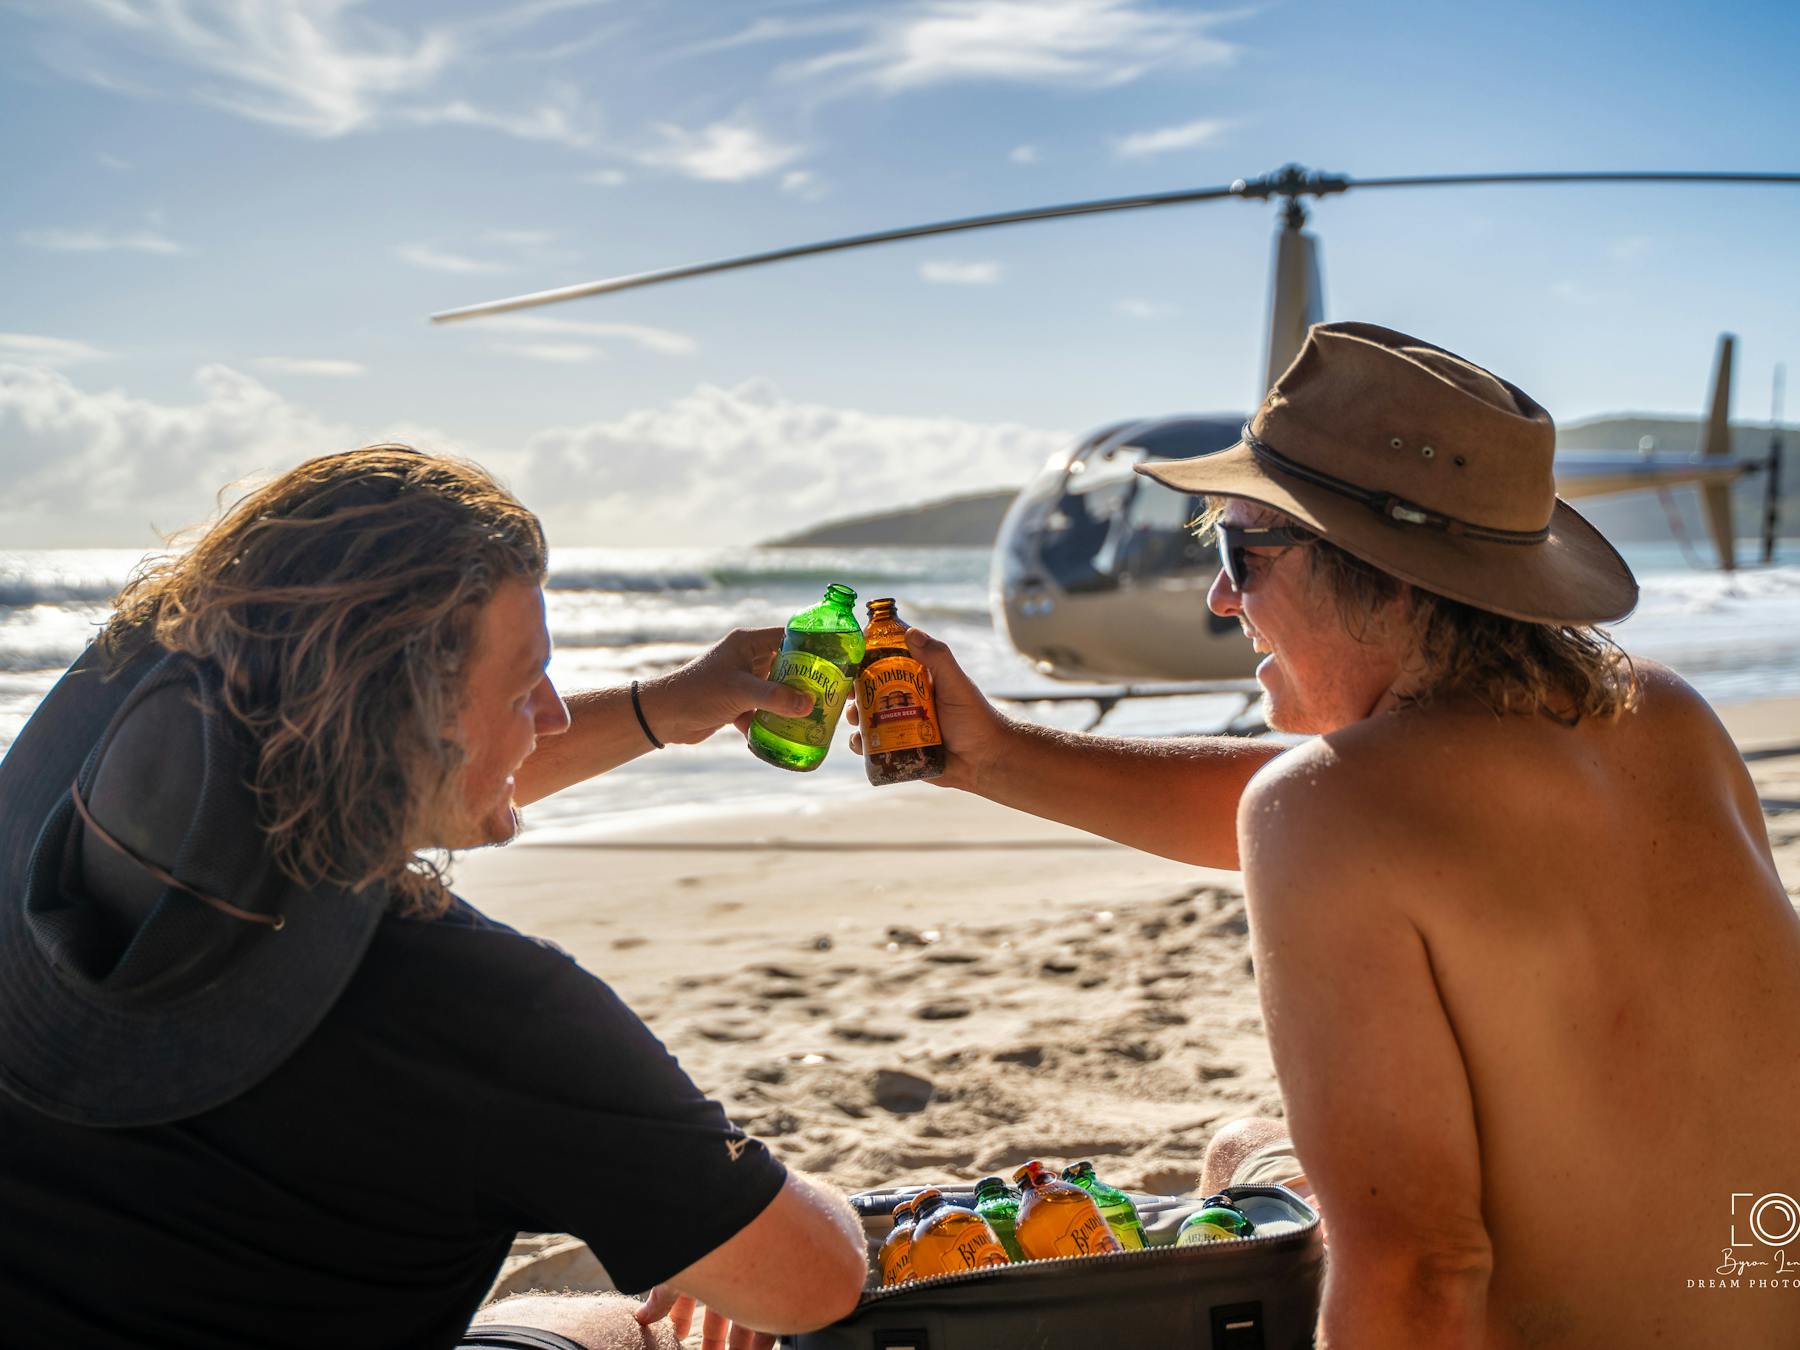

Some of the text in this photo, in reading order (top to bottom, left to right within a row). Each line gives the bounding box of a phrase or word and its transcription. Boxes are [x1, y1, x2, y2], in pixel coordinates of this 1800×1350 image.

[777, 659, 839, 707] BUNDABERG
[863, 669, 927, 709] BUNDABERG
[880, 712, 901, 720] GINGER
[1070, 1215, 1104, 1255] BUND
